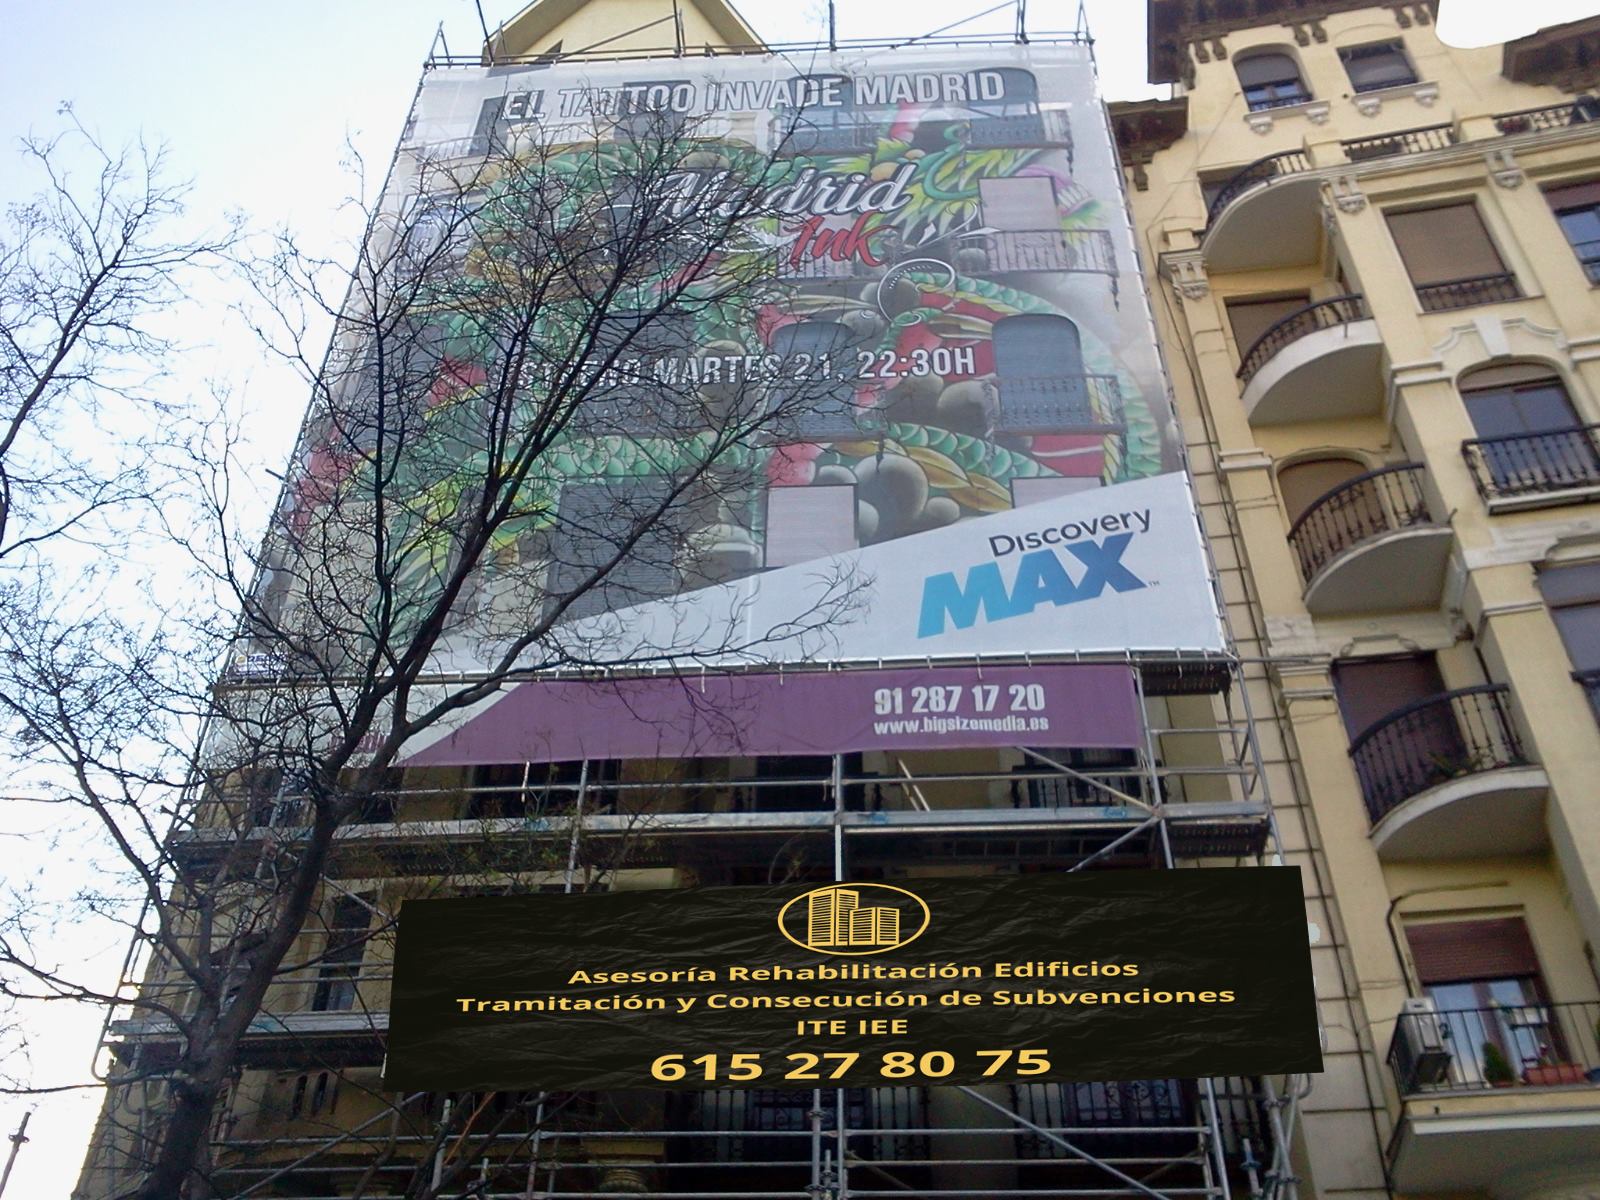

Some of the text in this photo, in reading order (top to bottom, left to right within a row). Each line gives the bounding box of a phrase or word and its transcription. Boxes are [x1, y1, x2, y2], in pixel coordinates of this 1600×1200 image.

[501, 70, 1006, 120] EL TATTOO INVADE MADRID
[783, 208, 900, 270] Ink
[652, 354, 783, 386] MARTES
[793, 352, 846, 384] 21,
[856, 346, 976, 379] 22:30H
[988, 508, 1151, 558] Discovery
[918, 531, 1148, 639] MAX
[874, 683, 1046, 716] 91 287 17 20
[873, 714, 1050, 735] www.bigsizemedia.es
[567, 960, 1138, 985] Asesoría Rehabilitación Edificios
[457, 987, 1235, 1014] Tramitación y Consecución de Subvenciones
[797, 1019, 908, 1036] ITE IEE
[650, 1048, 1051, 1082] 615 27 80 75
